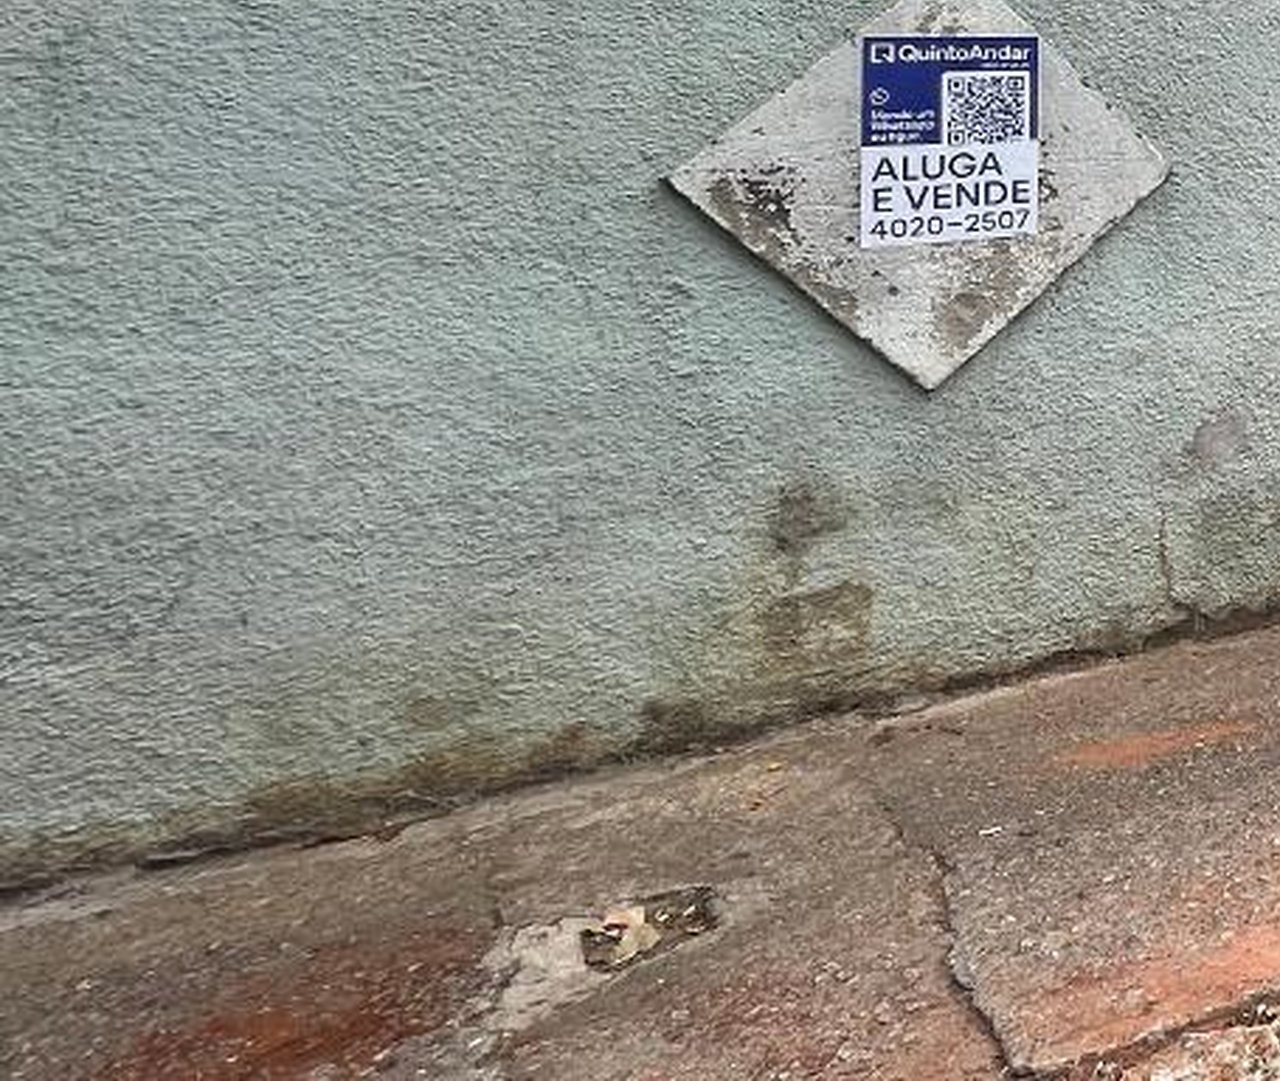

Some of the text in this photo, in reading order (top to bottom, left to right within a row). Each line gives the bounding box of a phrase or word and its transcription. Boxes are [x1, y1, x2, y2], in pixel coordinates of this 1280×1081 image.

[898, 44, 1031, 63] QuintoAndar
[871, 151, 1003, 183] ALUGA
[873, 179, 1031, 213] E VENDE
[869, 209, 1031, 240] 4020-2507
